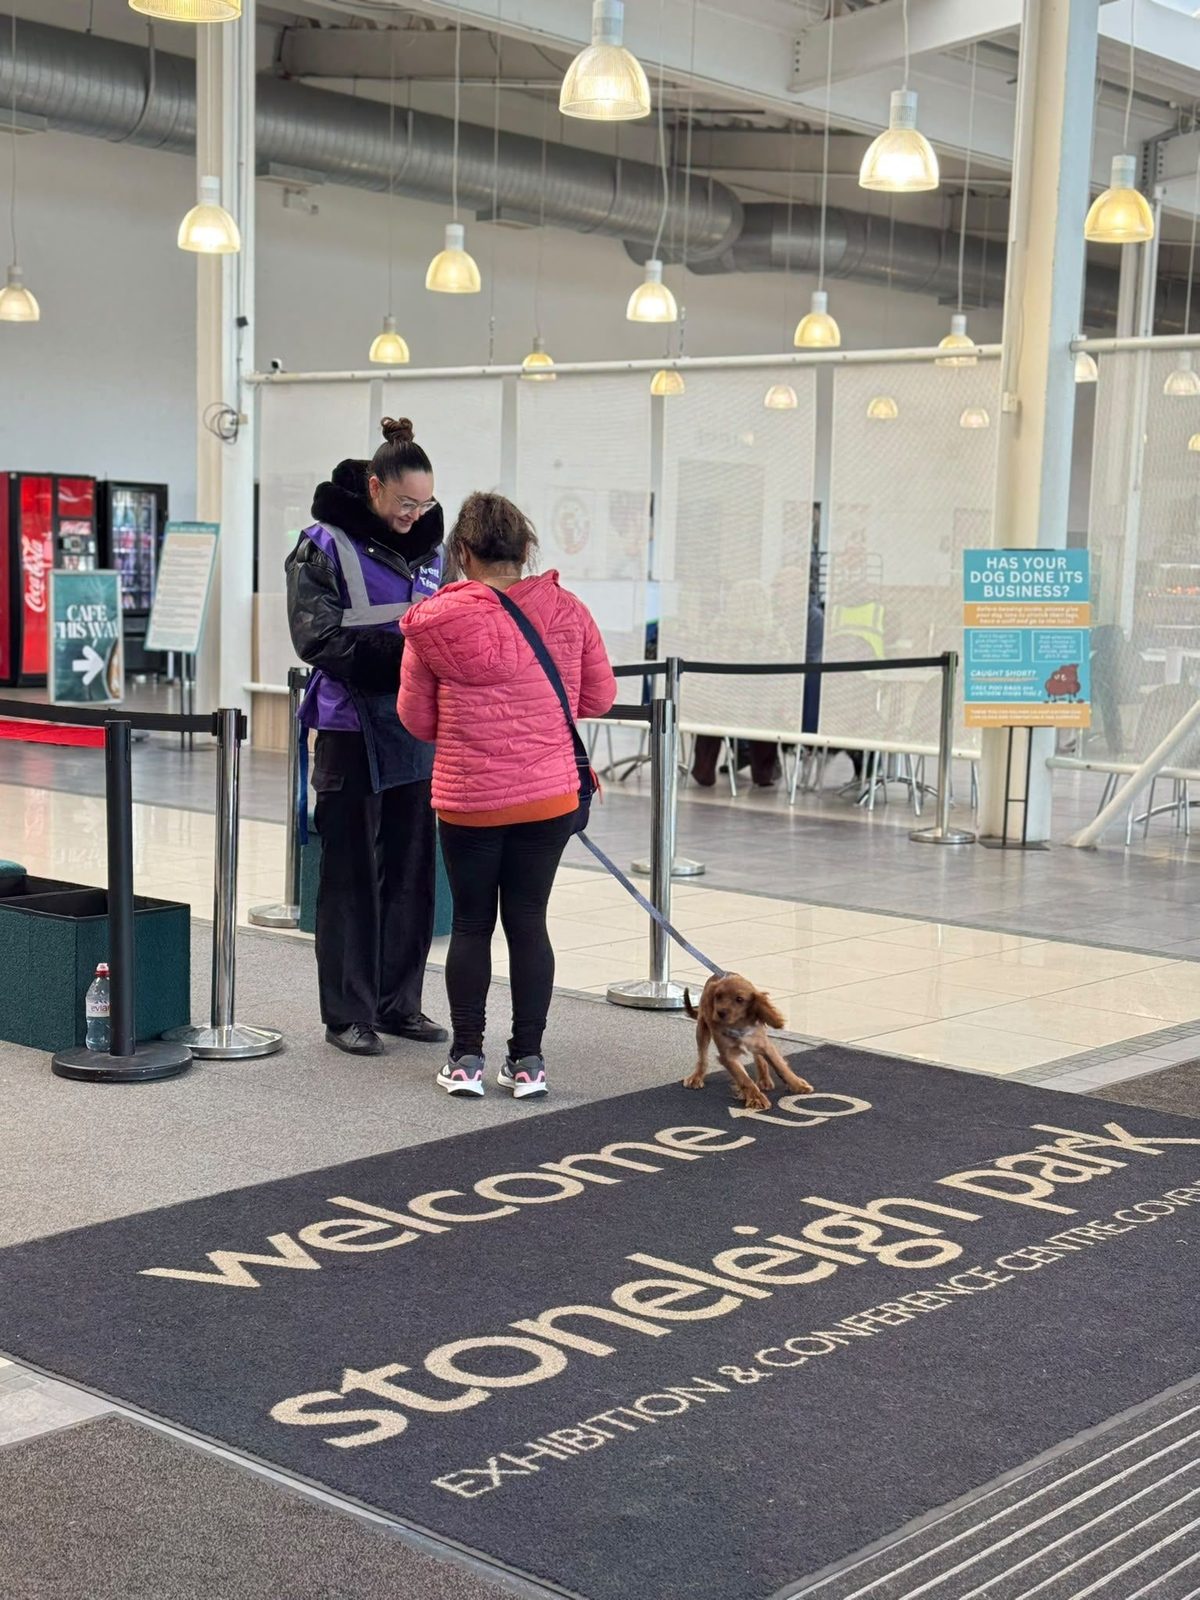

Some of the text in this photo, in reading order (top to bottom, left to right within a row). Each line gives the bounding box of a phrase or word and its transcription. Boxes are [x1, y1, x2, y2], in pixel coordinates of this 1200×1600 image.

[986, 557, 1067, 569] HAS YOUR
[970, 571, 1083, 583] DOG DONE ITS
[984, 585, 1070, 598] BUSINESS?
[66, 604, 108, 622] CAFE
[55, 621, 87, 639] THIS
[970, 669, 1037, 677] CAUGHT SHORT?
[137, 1092, 873, 1288] welcome to
[269, 1121, 1200, 1449] stoneleigh park
[430, 1180, 1200, 1498] EXHIBITION & CONFERENCE CENTRE COVE
